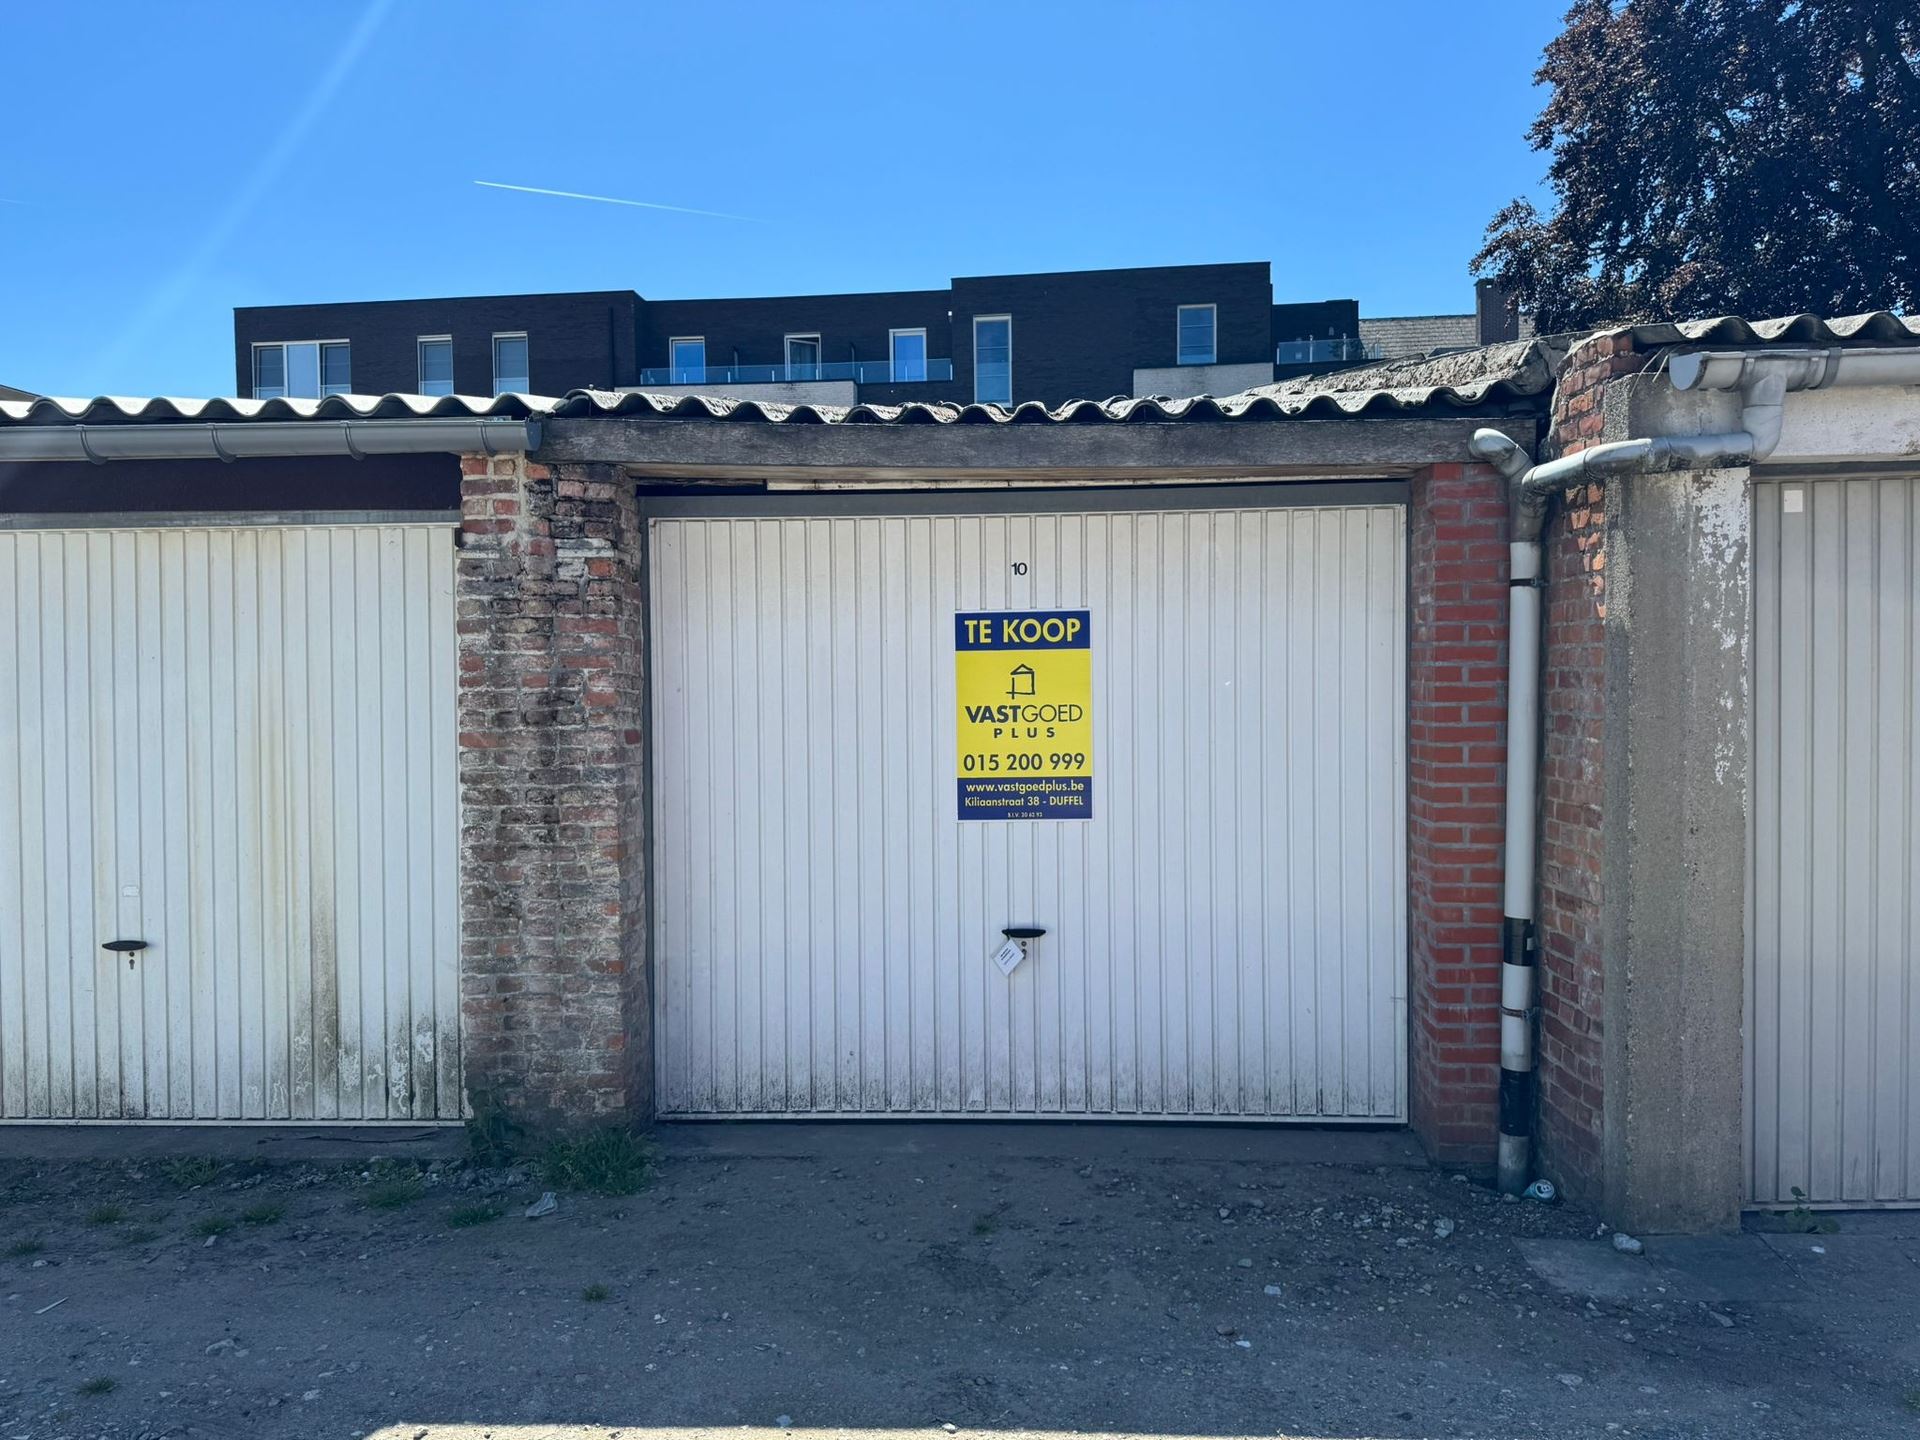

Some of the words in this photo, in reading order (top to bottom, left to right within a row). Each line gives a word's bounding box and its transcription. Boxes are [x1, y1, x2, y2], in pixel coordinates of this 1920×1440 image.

[1011, 562, 1028, 575] 10
[964, 619, 992, 644] TE
[1003, 618, 1081, 643] KOOP
[965, 704, 1083, 723] VASTGOED
[994, 728, 1055, 738] PLUS
[964, 754, 999, 771] 015
[1006, 754, 1042, 771] 200
[1050, 753, 1085, 770] 999
[966, 780, 1084, 794] www.vastgoedplus.be
[965, 797, 1024, 807] Kiliaanstraat
[1028, 796, 1040, 806] 38
[1050, 796, 1083, 806] DUFFEL
